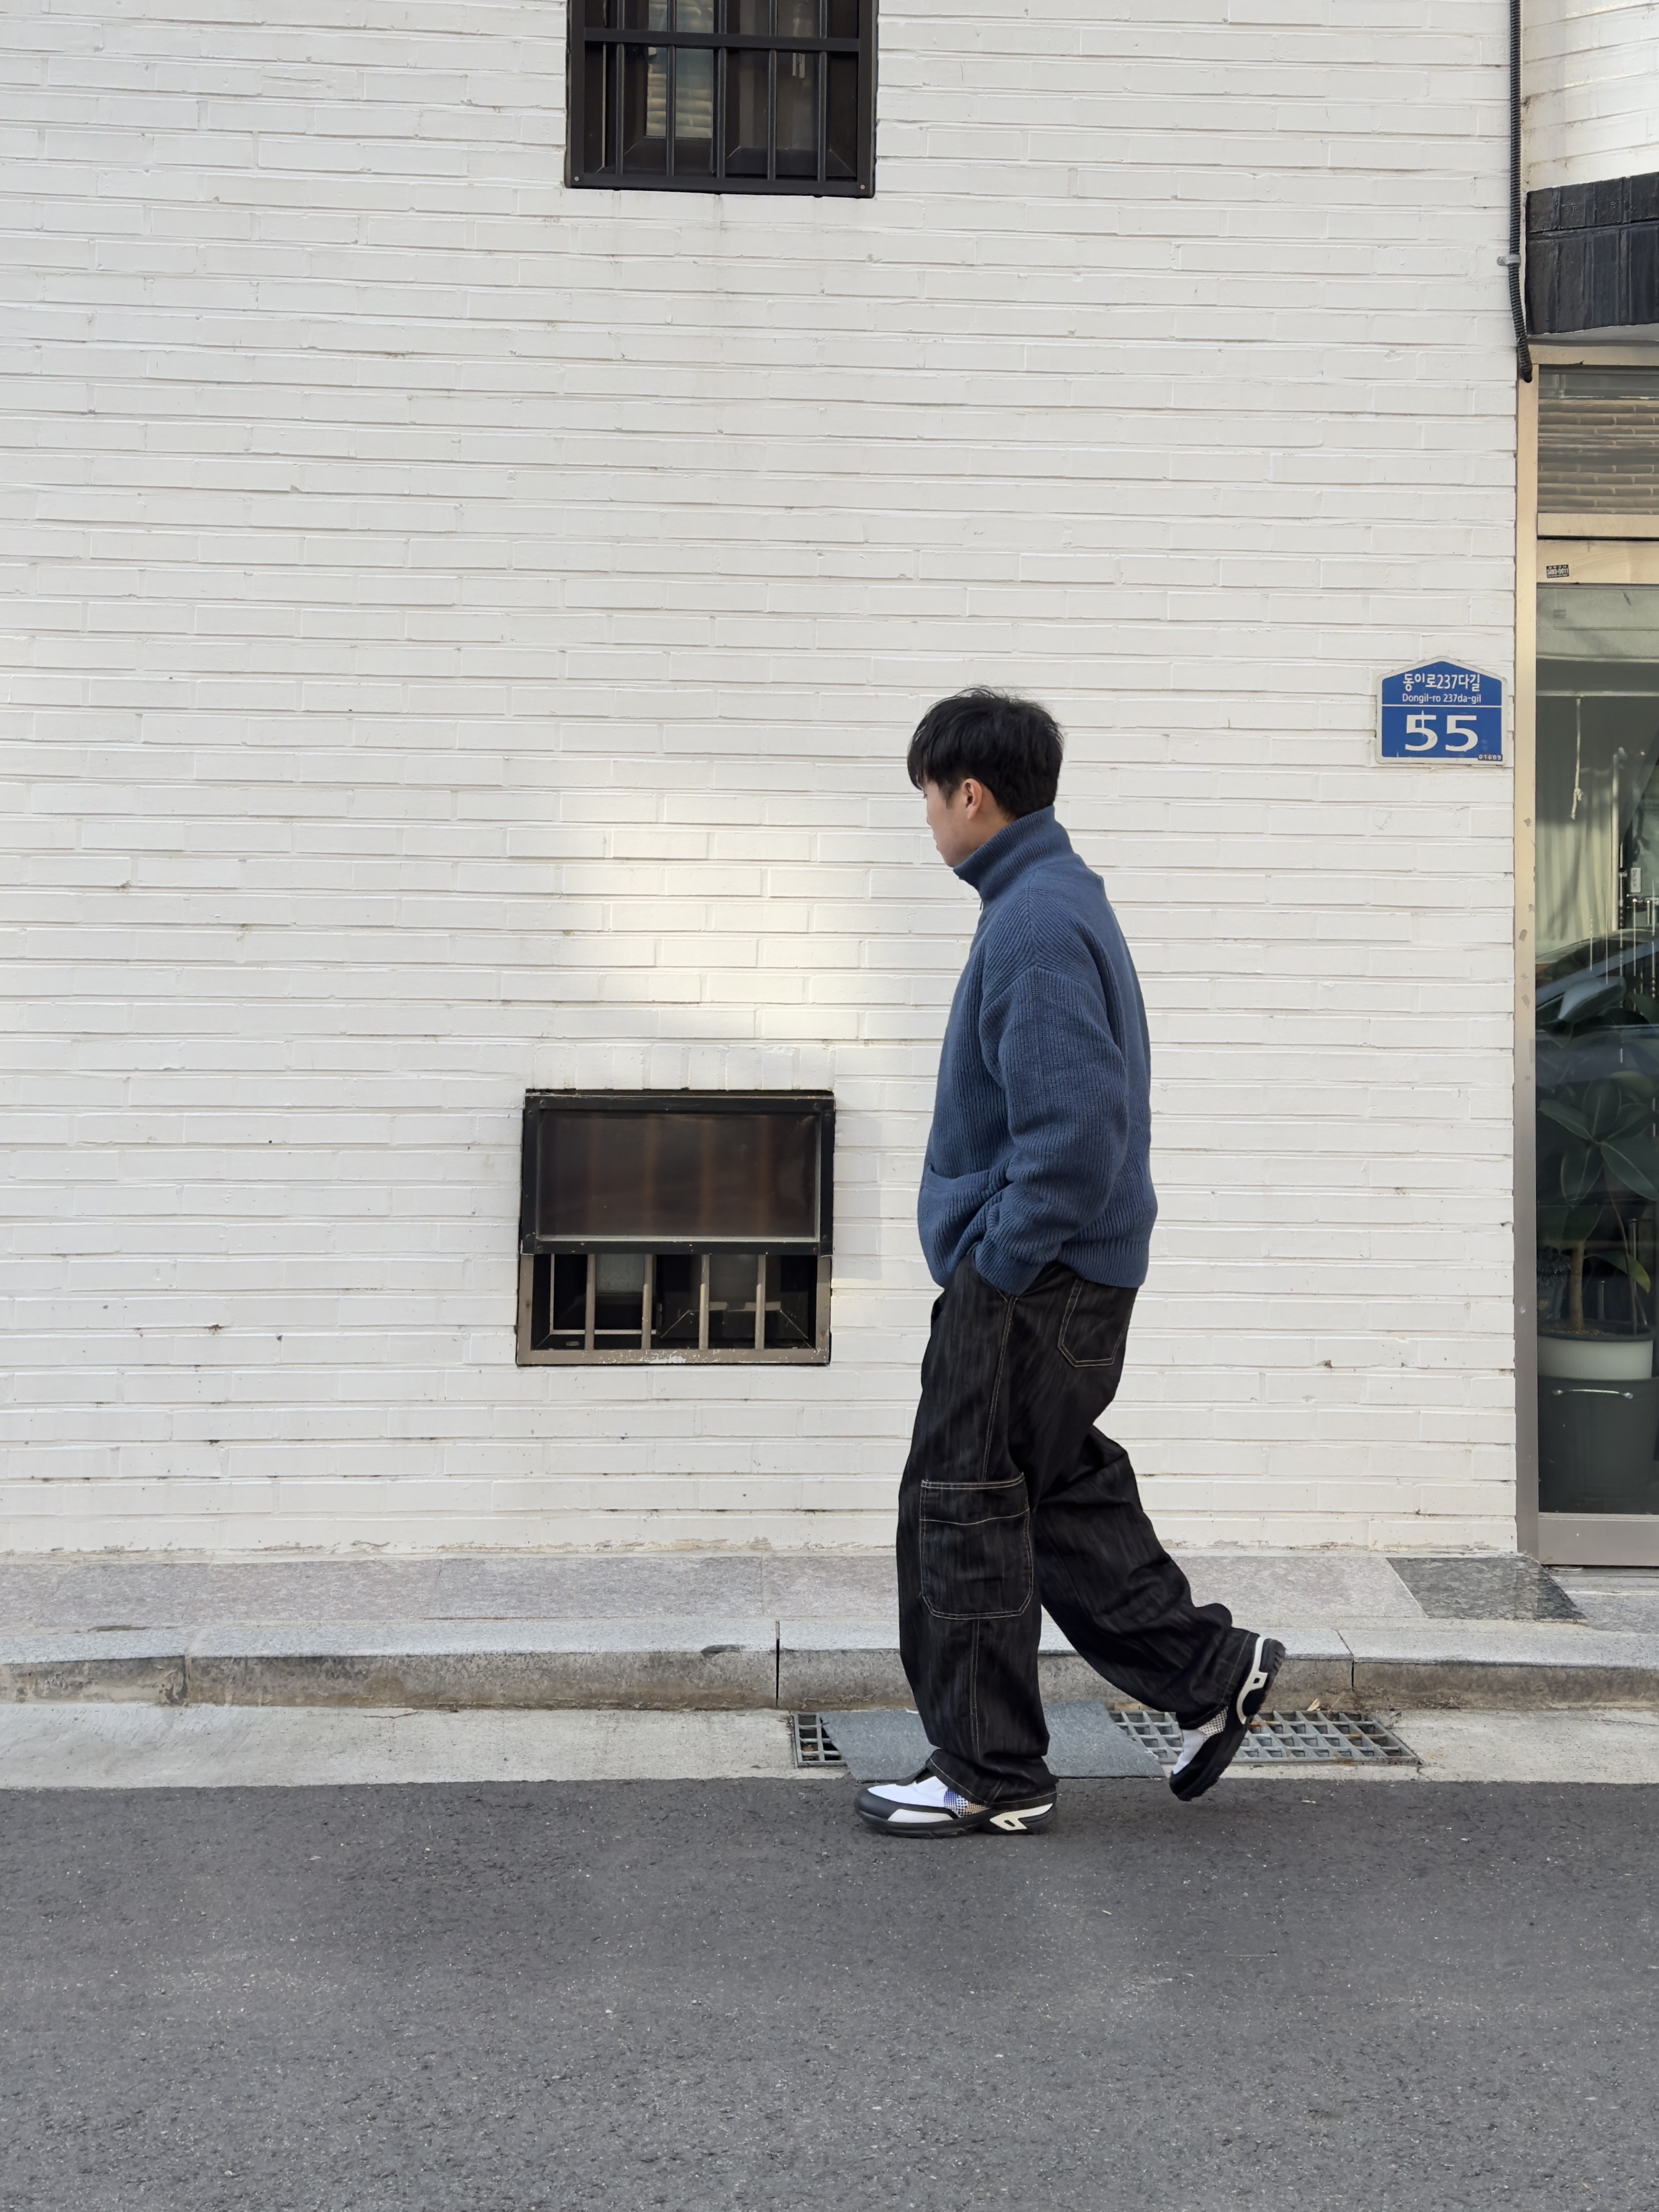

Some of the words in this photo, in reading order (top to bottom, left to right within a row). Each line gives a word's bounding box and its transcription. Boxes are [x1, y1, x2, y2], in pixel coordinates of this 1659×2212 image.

[1402, 693, 1441, 703] Dongil-ro
[1443, 694, 1481, 704] 237da-gil
[1405, 714, 1478, 752] 55
